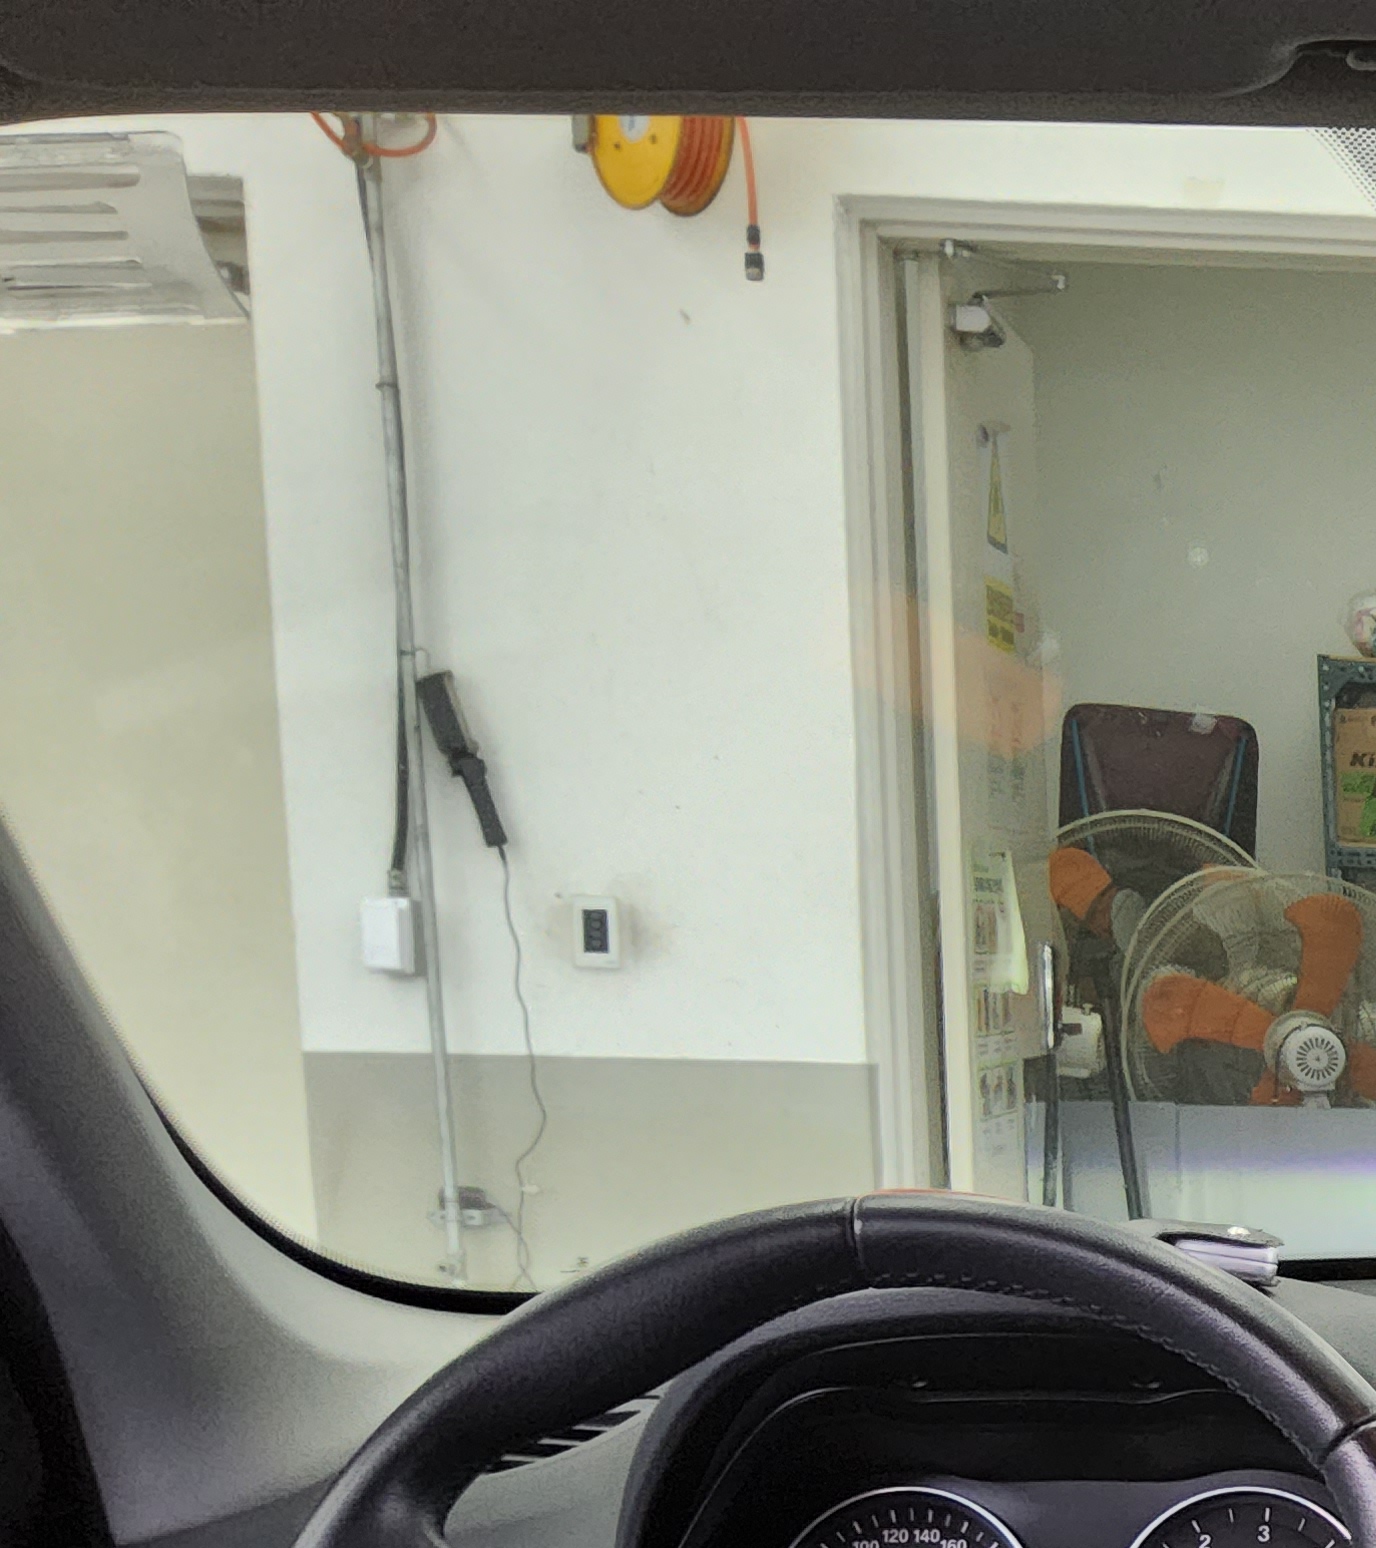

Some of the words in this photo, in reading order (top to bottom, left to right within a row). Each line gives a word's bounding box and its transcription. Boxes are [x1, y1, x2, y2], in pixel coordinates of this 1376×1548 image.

[882, 1529, 909, 1543] 120
[914, 1529, 940, 1543] 140
[1257, 1525, 1270, 1542] 3
